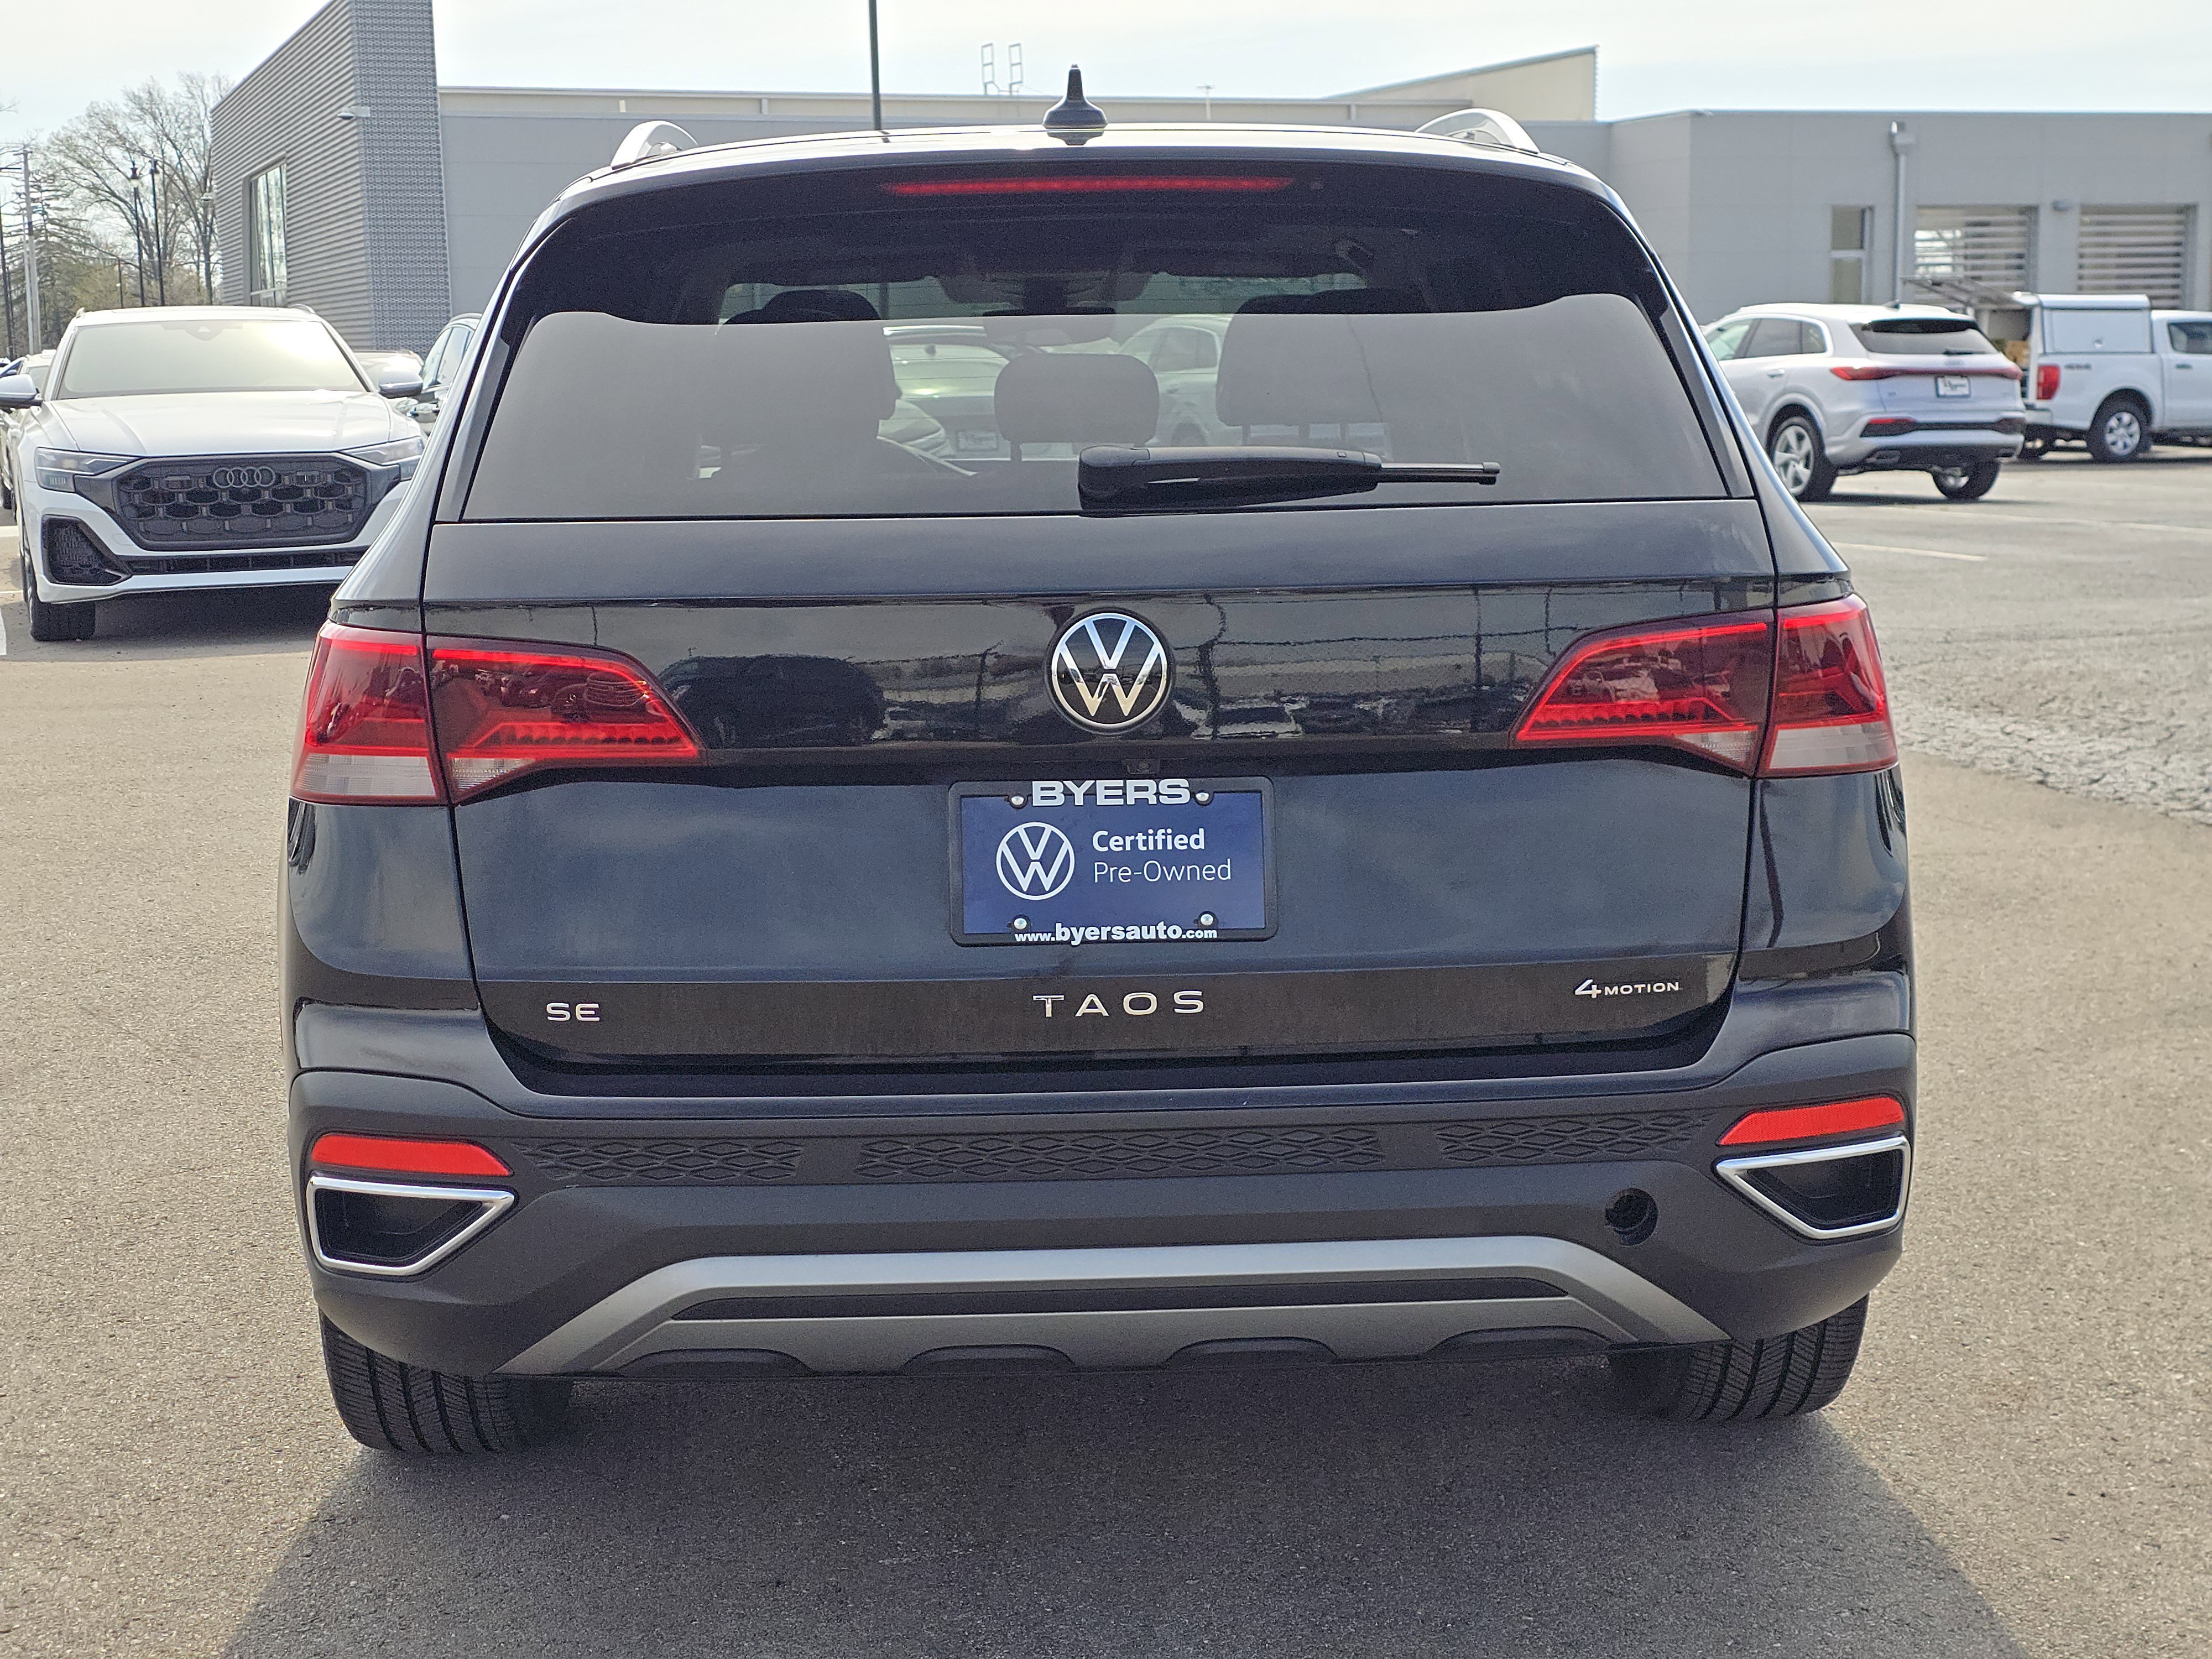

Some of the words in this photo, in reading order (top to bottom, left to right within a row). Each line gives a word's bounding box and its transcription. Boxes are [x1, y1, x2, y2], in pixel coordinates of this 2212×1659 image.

[1032, 779, 1191, 806] BYERS
[1092, 828, 1206, 852] Certified
[1093, 858, 1232, 883] Pre-Owned
[1014, 921, 1218, 946] www.byersauto.com
[1574, 979, 1679, 999] 4MOTION
[546, 1002, 601, 1022] SE
[1032, 990, 1204, 1018] TAOS
